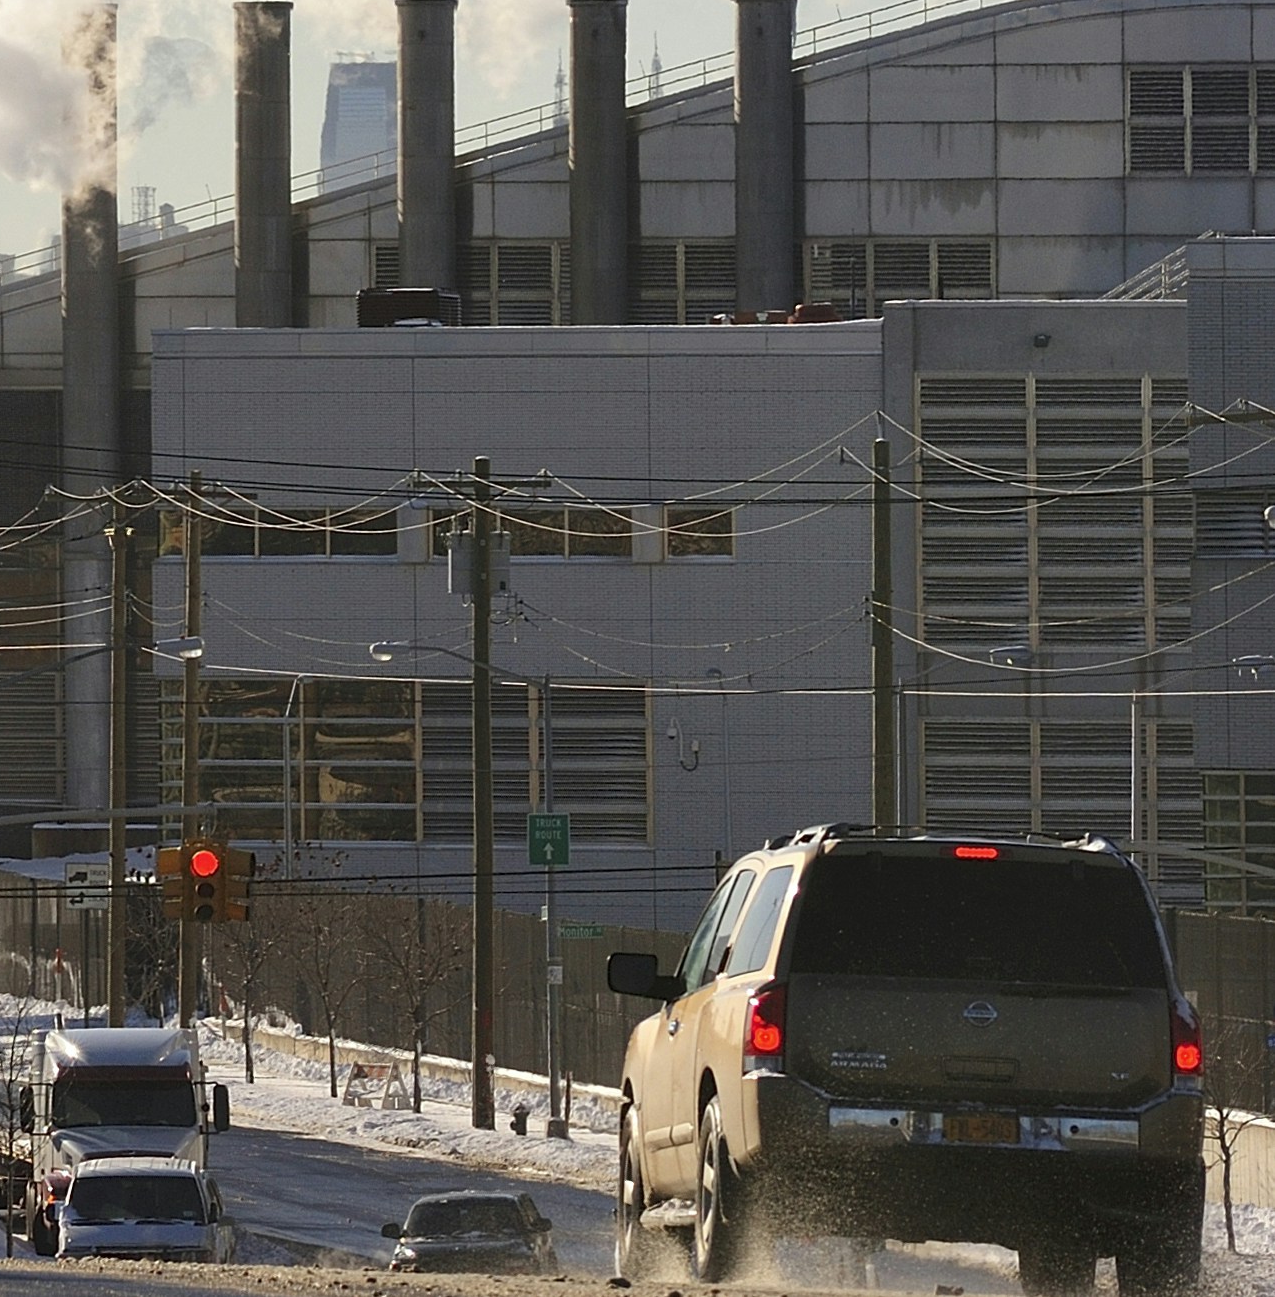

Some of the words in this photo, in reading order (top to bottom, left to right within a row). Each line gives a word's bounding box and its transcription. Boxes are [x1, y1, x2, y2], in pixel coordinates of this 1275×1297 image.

[535, 818, 562, 827] TRUCK
[535, 830, 562, 839] ROUTE
[558, 926, 594, 937] Monitor
